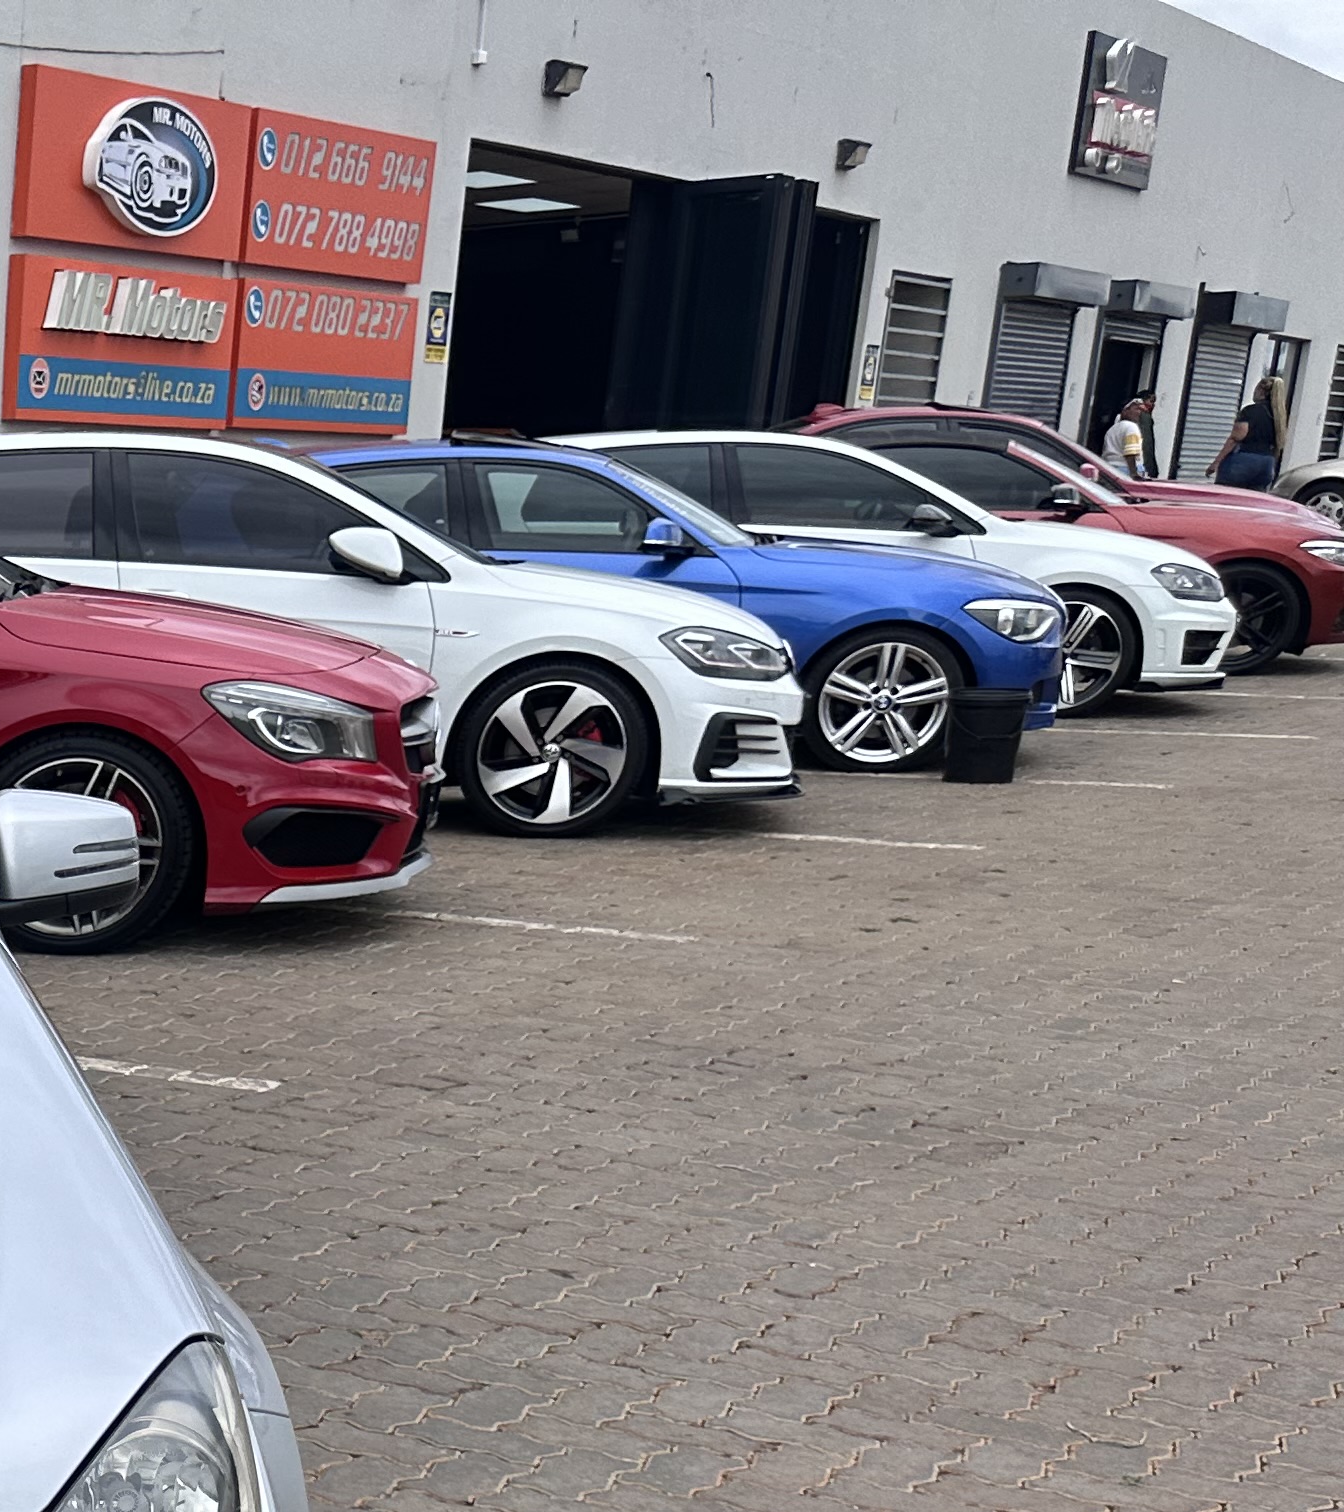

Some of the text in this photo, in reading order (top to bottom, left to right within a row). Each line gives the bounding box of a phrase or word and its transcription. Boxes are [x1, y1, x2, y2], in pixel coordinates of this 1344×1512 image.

[152, 106, 213, 169] MR. MOTORS
[280, 132, 429, 196] 012 666 9144
[274, 203, 420, 261] 072 788 4998
[43, 270, 227, 343] MR. Motors
[265, 289, 410, 340] 072 080 2237
